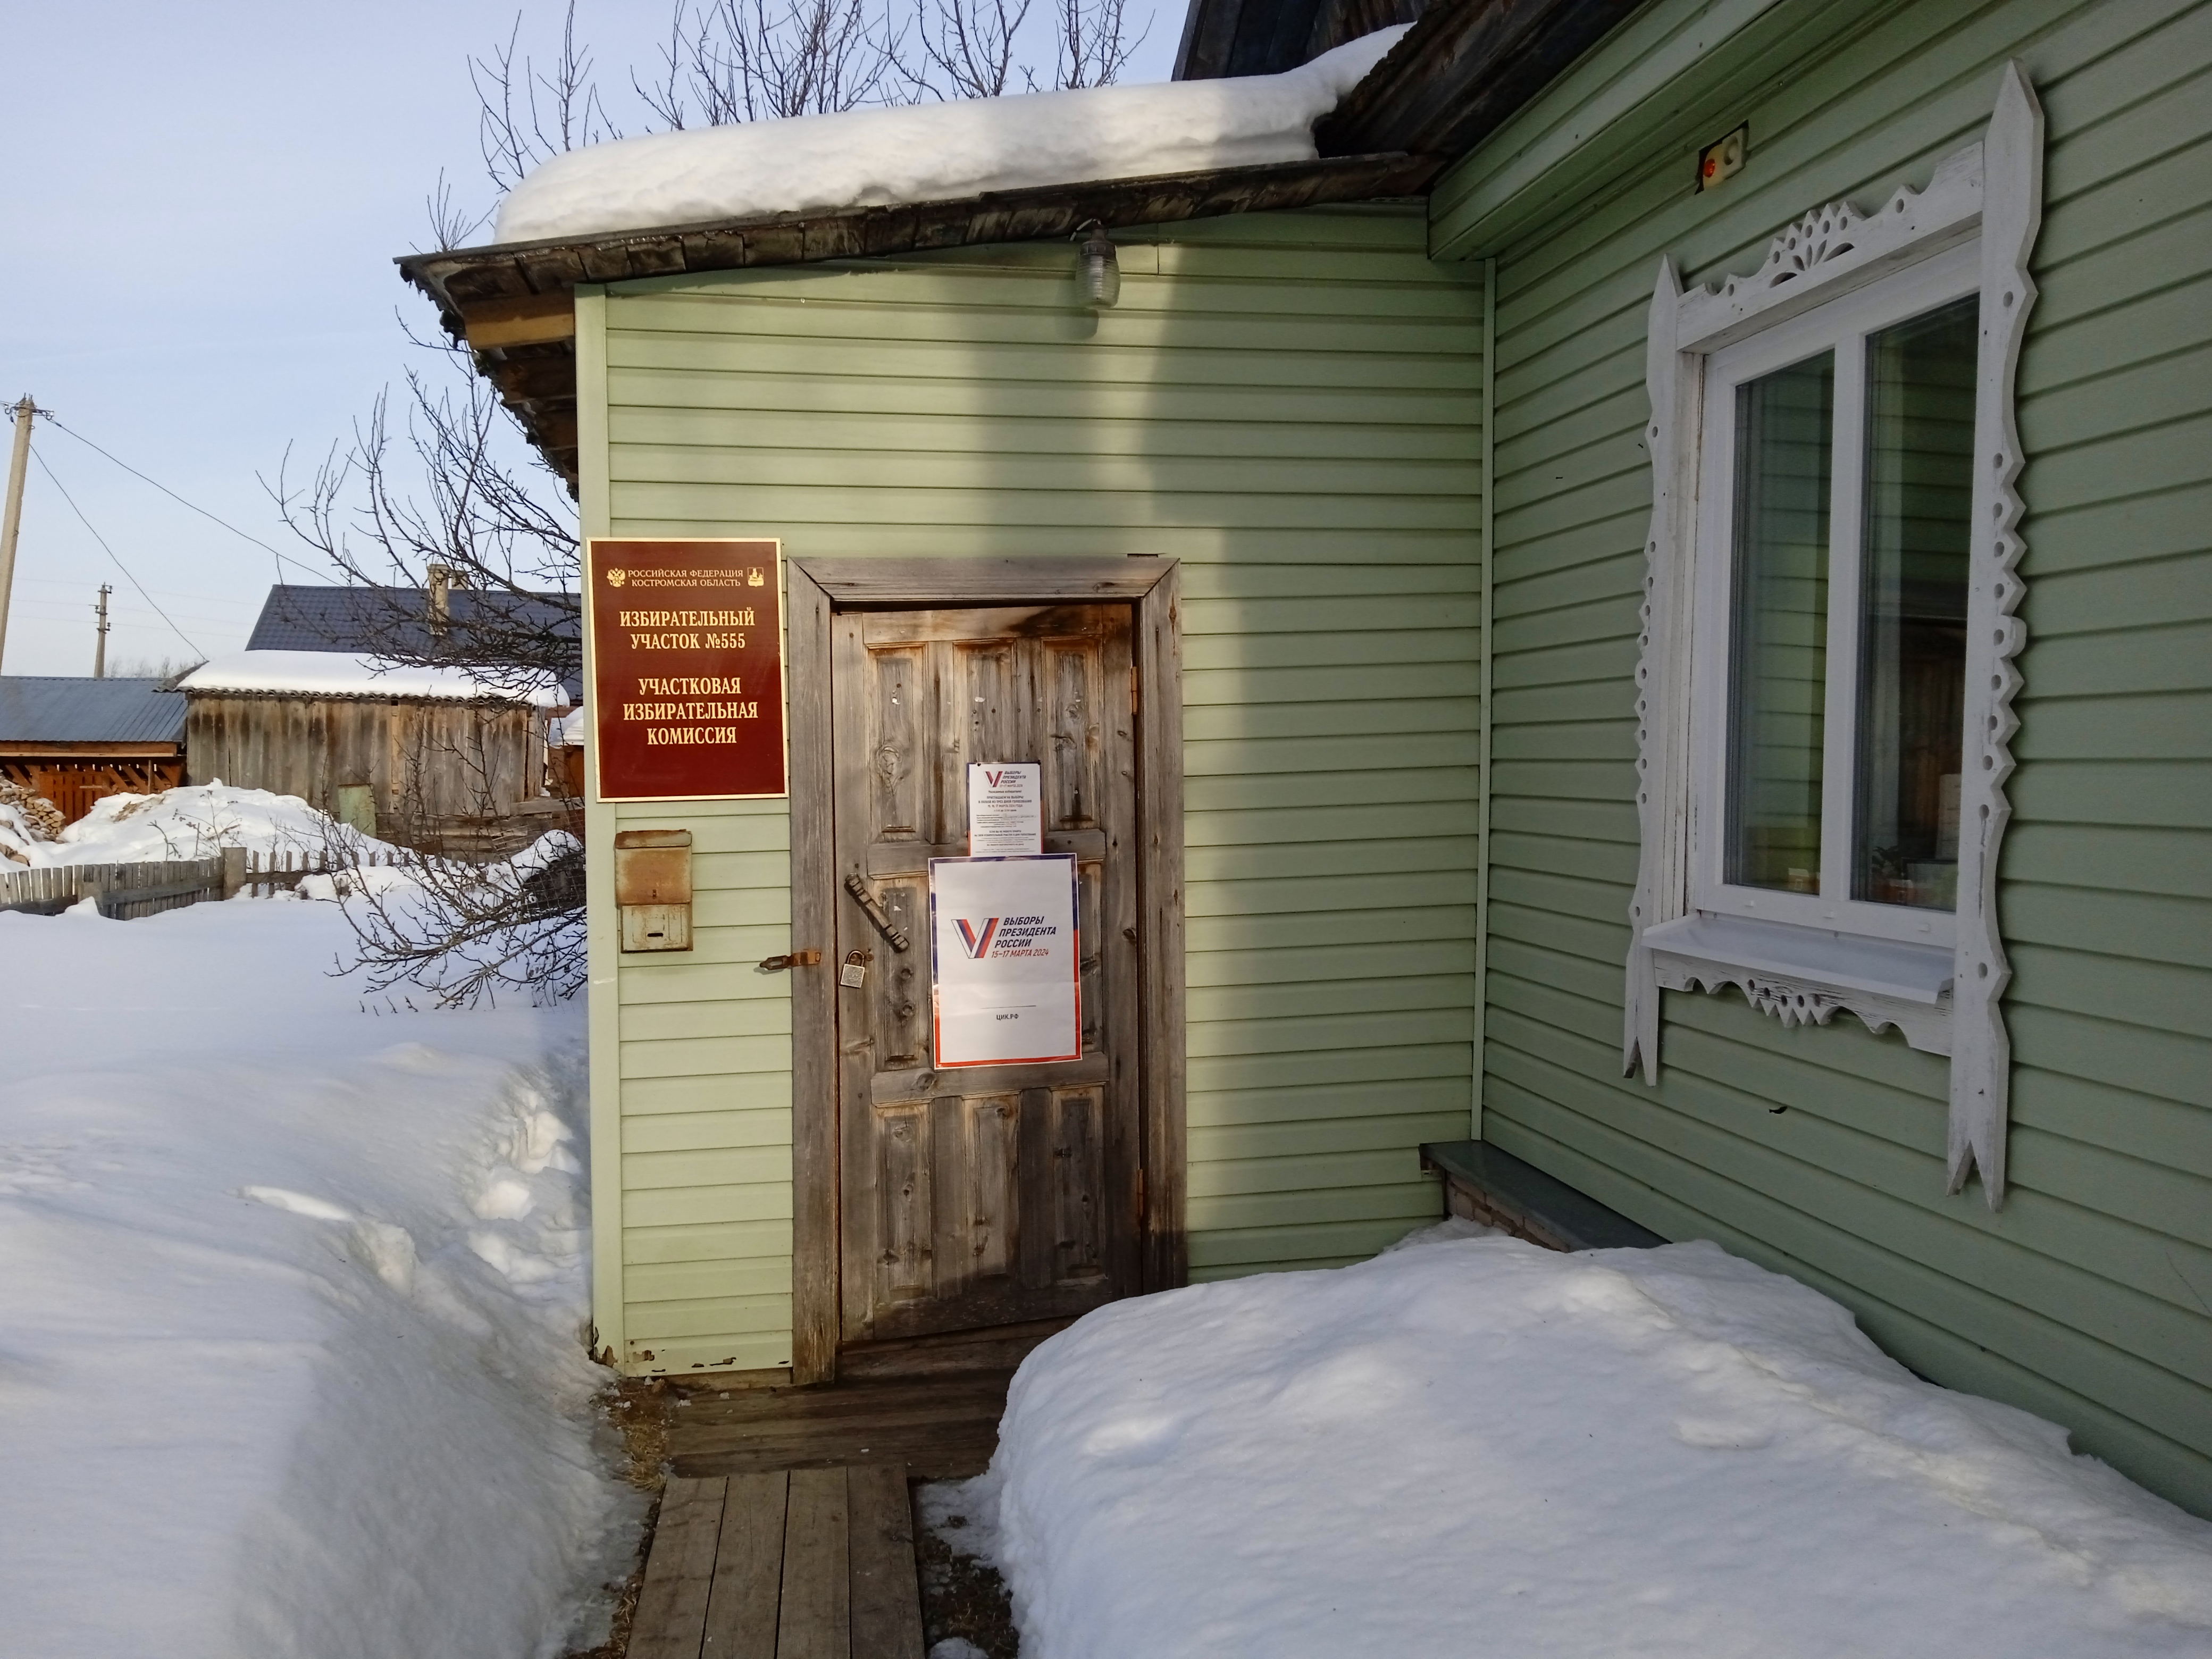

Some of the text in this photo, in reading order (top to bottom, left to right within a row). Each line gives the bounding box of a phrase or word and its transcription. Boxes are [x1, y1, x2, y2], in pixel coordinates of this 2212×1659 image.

[628, 568, 743, 578] РОССИЙСКАЯ ФЕДЕРАЦИЯ
[619, 607, 755, 627] ИЗБИРАТЕЛЬНЫЙ
[630, 633, 745, 649] УЧАСТОК №555
[638, 677, 741, 695] УЧАСТКОВАЯ
[623, 701, 758, 720] ИЗБИРАТЕЛЬНАЯ
[647, 727, 736, 745] КОМИССИЯ
[1003, 916, 1044, 926] ВЫБОРЫ
[999, 927, 1056, 937] ПРЕЗИДЕНТА
[994, 939, 1032, 949] РОССИИ
[1010, 949, 1032, 958] МАРТА
